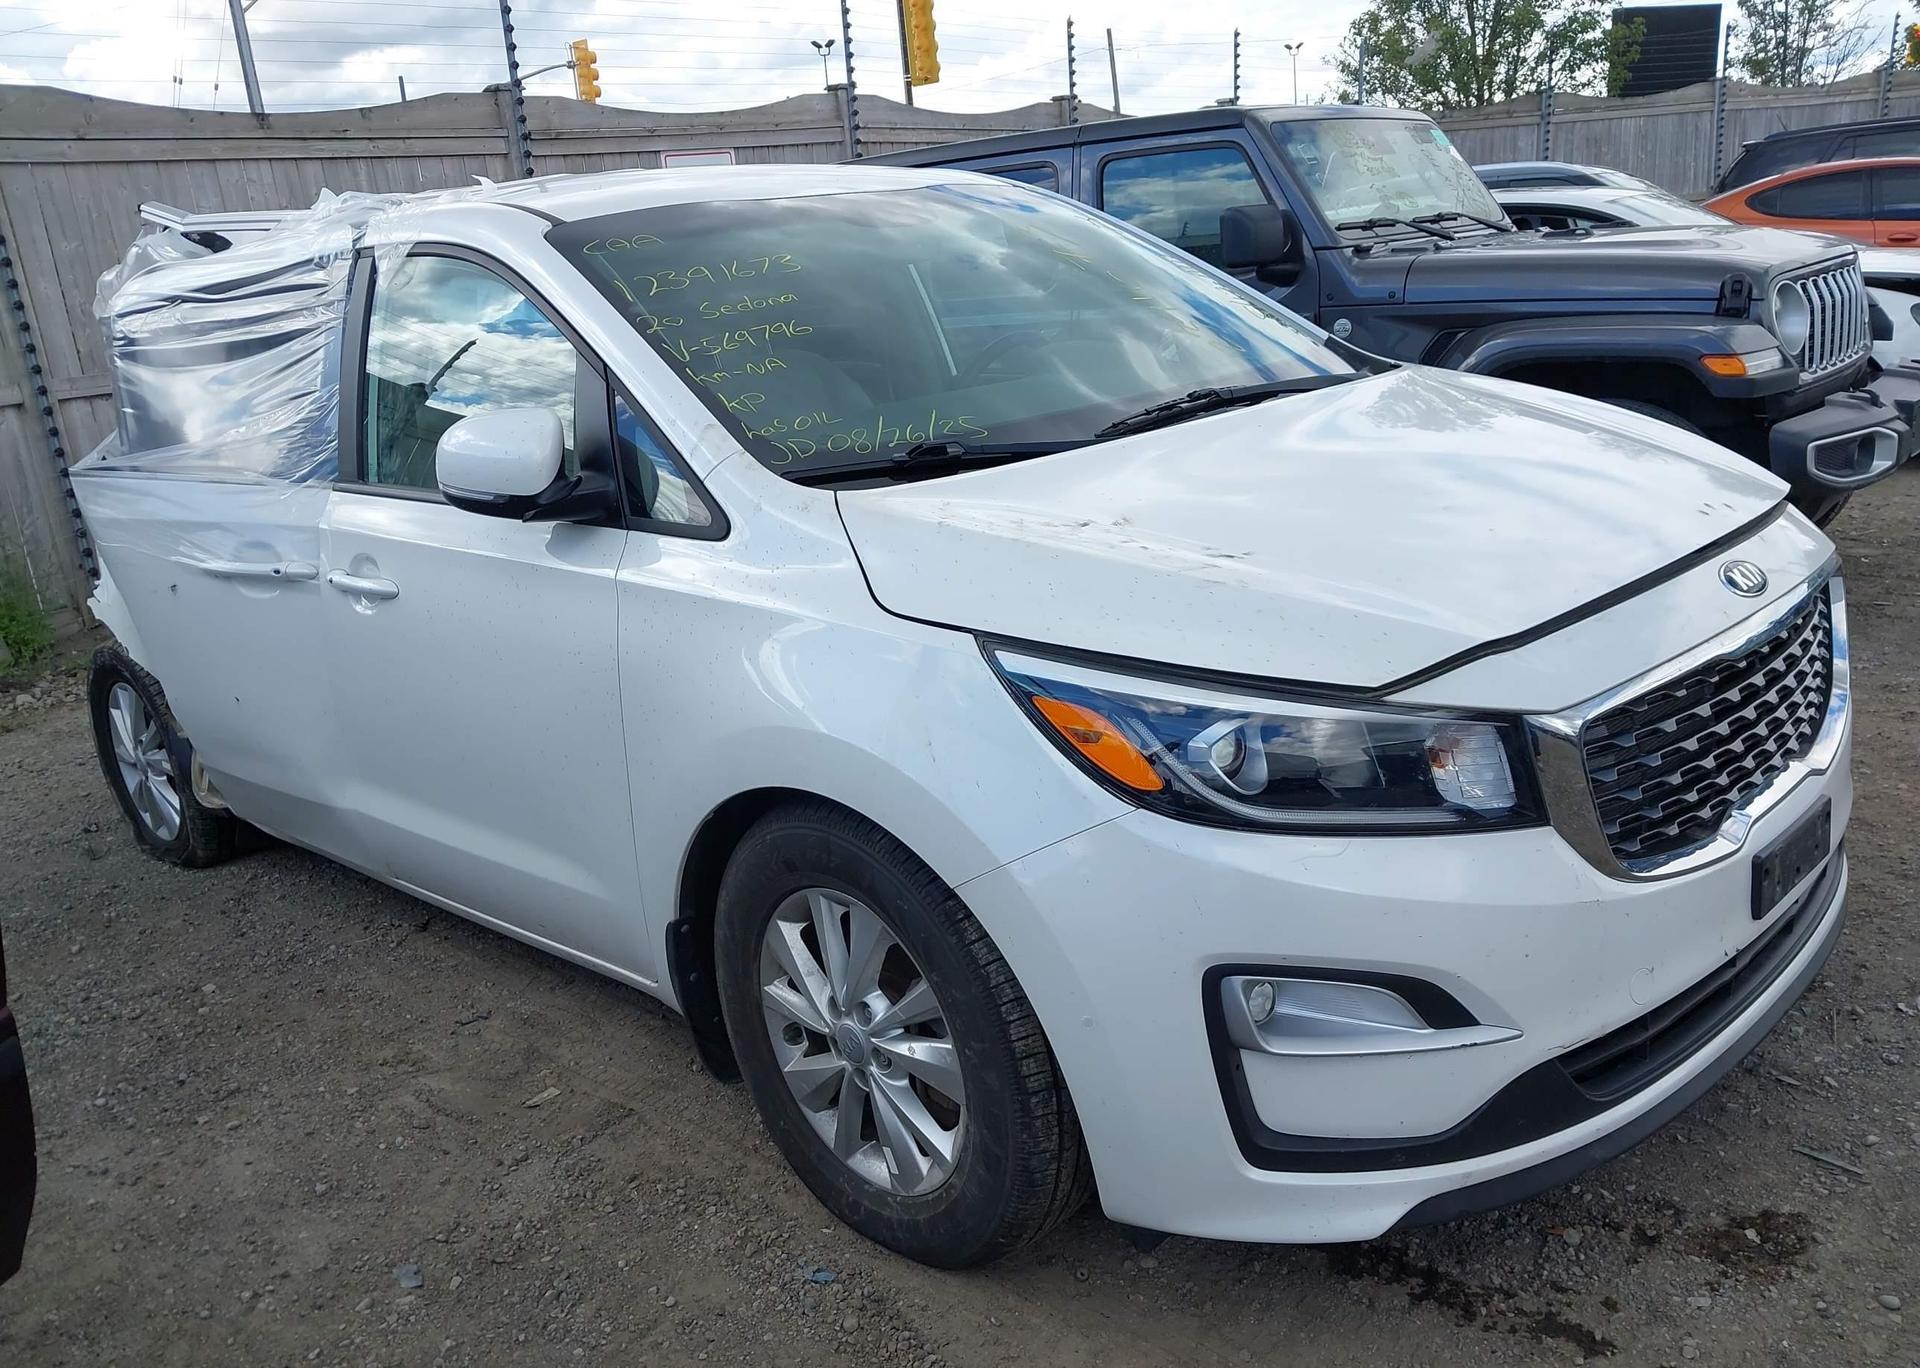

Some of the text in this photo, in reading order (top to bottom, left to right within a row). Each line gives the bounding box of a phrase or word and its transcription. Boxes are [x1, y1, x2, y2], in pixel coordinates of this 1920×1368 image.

[583, 234, 664, 255] CAA
[699, 295, 798, 319] Sedona
[827, 409, 989, 455] 08/26/25
